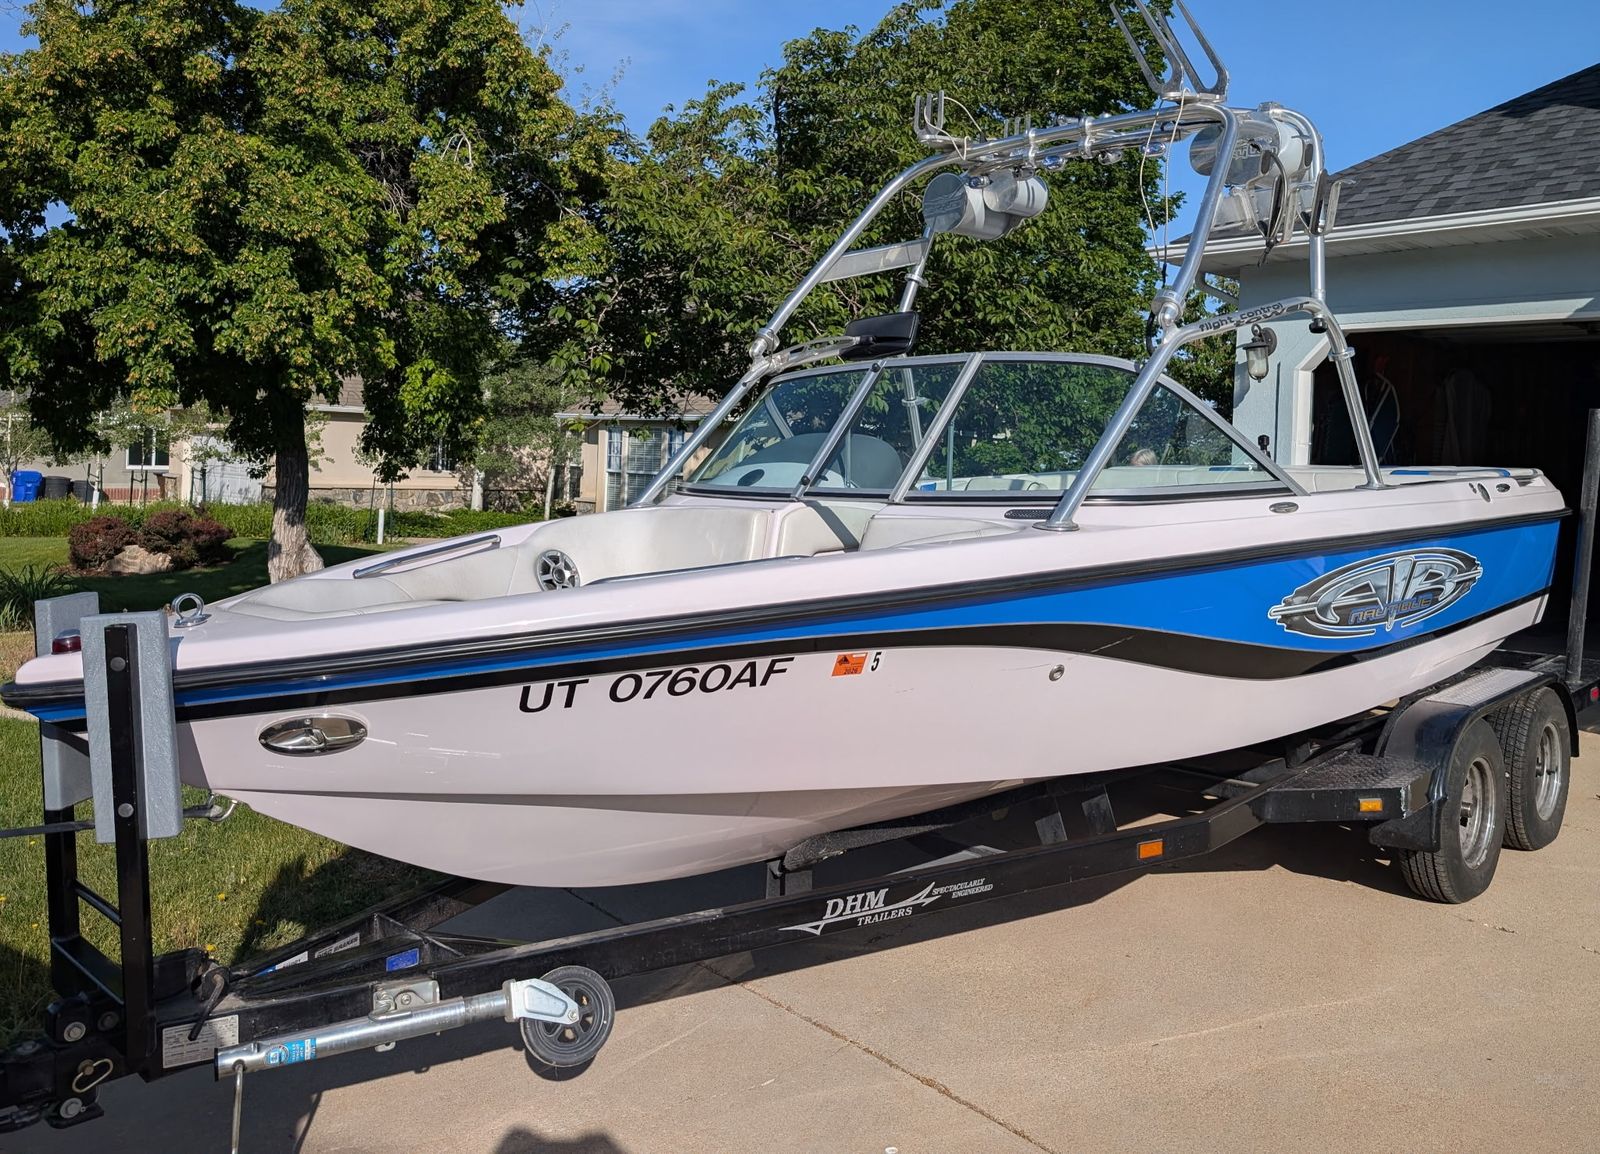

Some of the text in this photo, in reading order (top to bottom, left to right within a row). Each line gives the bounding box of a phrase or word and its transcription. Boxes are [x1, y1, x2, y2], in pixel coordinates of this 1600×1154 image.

[1239, 302, 1284, 320] control
[518, 651, 882, 713] UT 0760AF 5
[931, 878, 986, 896] SPECTACULARLY
[951, 884, 994, 899] ENGINEERED
[822, 888, 889, 920] DHM
[856, 907, 913, 926] TRAILERS
